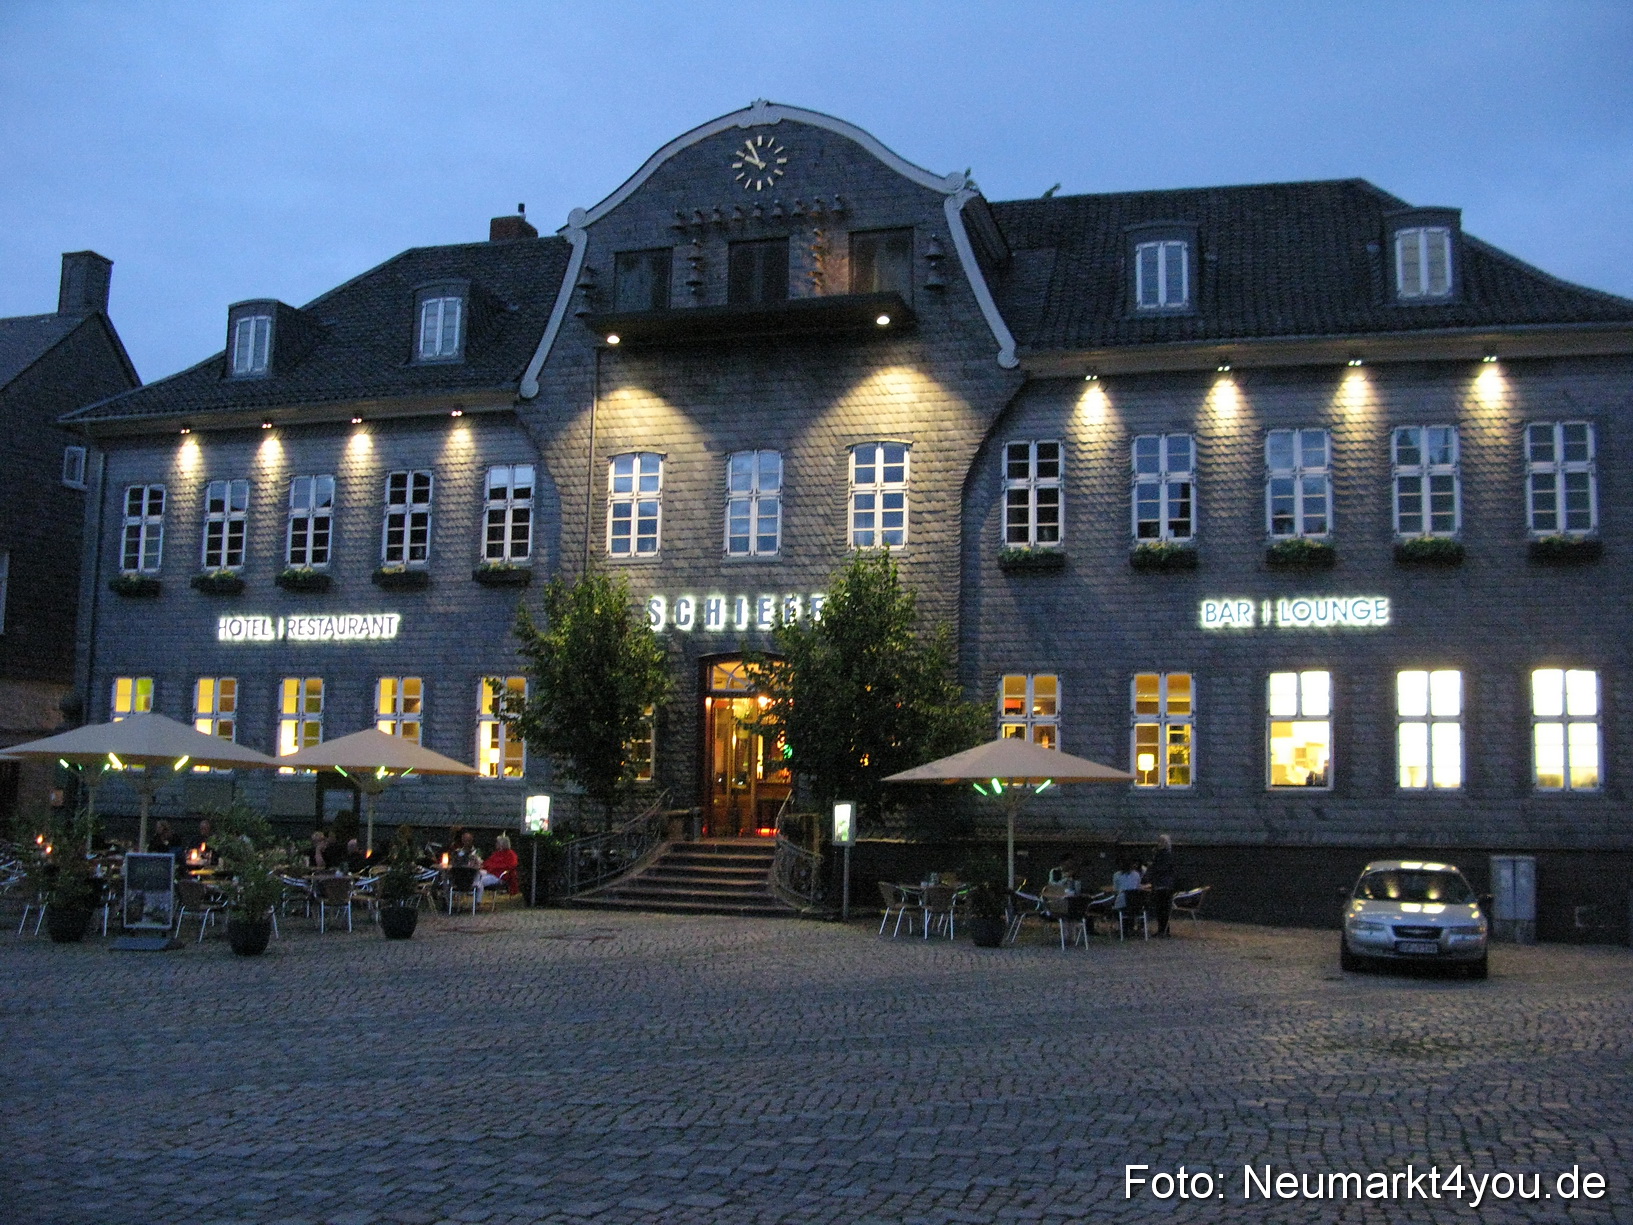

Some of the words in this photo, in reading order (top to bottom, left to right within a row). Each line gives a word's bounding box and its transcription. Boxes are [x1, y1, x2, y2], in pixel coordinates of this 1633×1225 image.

[1204, 602, 1251, 623] BAR
[1280, 599, 1387, 622] LOUNGE
[218, 617, 272, 638] HOTEL
[287, 615, 398, 638] RESTAURANT
